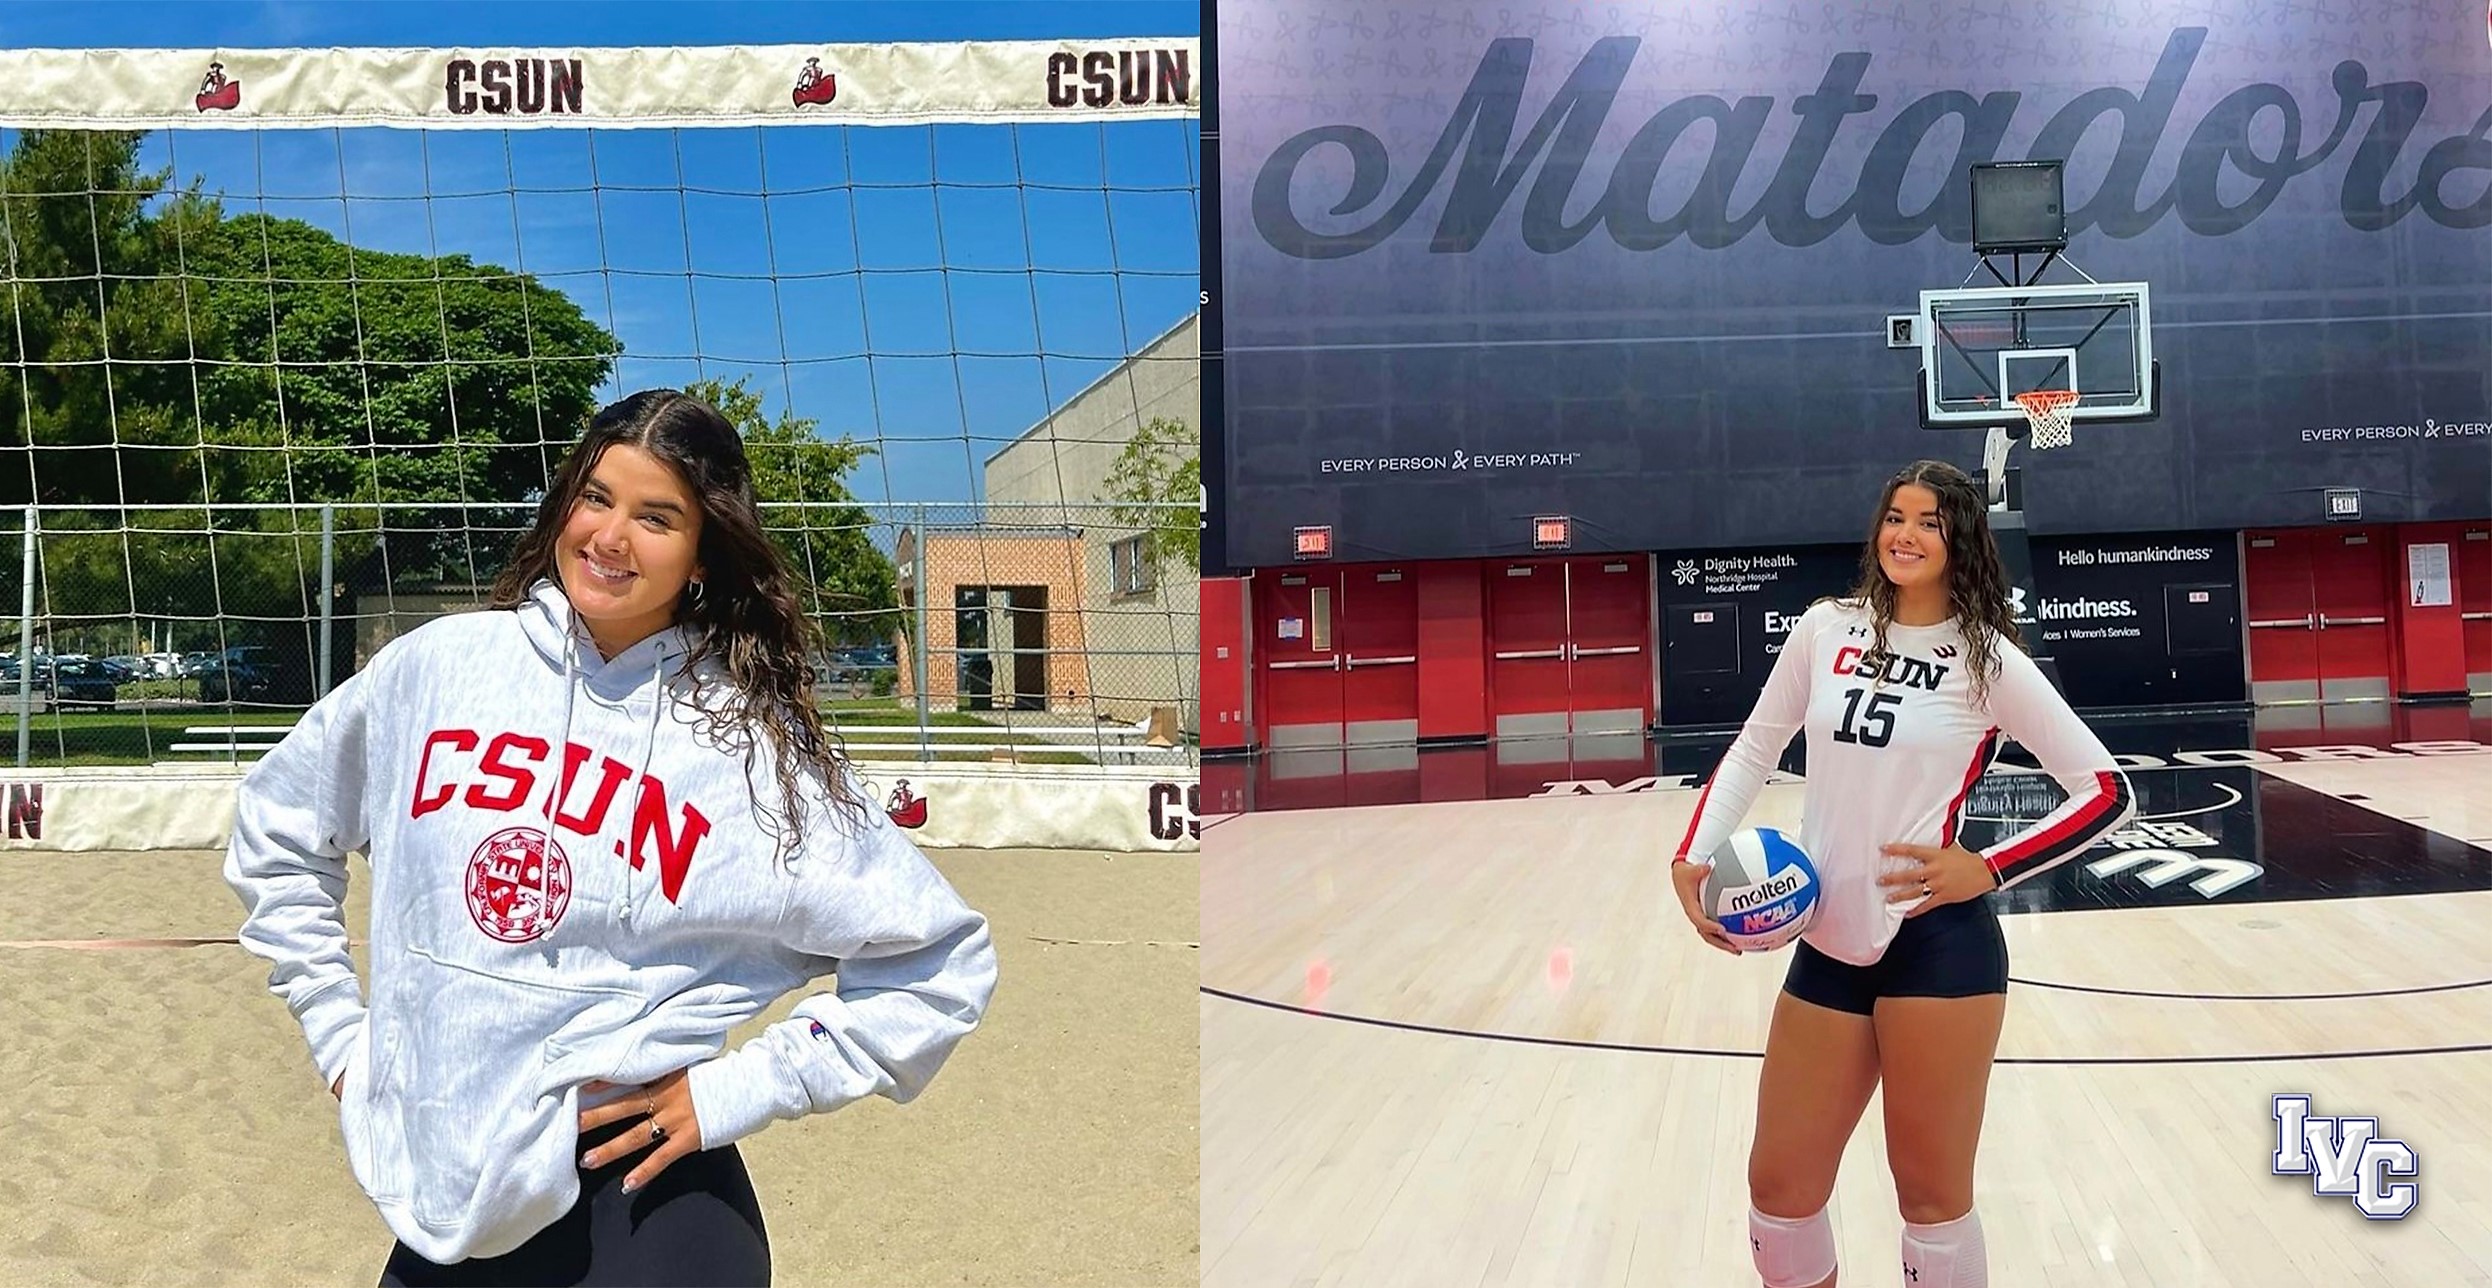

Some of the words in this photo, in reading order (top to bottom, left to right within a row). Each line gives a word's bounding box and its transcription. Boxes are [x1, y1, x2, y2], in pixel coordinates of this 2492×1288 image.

[445, 59, 584, 115] CSUN
[1047, 49, 1190, 108] CSUN
[2301, 428, 2352, 441] EVERY
[2356, 425, 2420, 439] PERSON
[1321, 459, 1375, 473] EVERY
[1379, 456, 1447, 471] PERSON
[1451, 450, 1469, 470] &
[1474, 453, 1527, 468] EVERY
[1705, 557, 1751, 574] Dignity
[2058, 549, 2095, 565] Hello
[1705, 573, 1746, 584] Northridge
[1747, 571, 1778, 583] Hospital
[1705, 583, 1734, 594] Medical
[1735, 583, 1760, 592] Center
[2037, 596, 2138, 620] kindness.
[2070, 627, 2107, 639] Women's
[1833, 646, 1949, 691] CSUN
[1833, 688, 1903, 748] 15
[411, 729, 712, 904] CSUN
[1732, 875, 1798, 912] molten
[1742, 899, 1797, 934] NCAA
